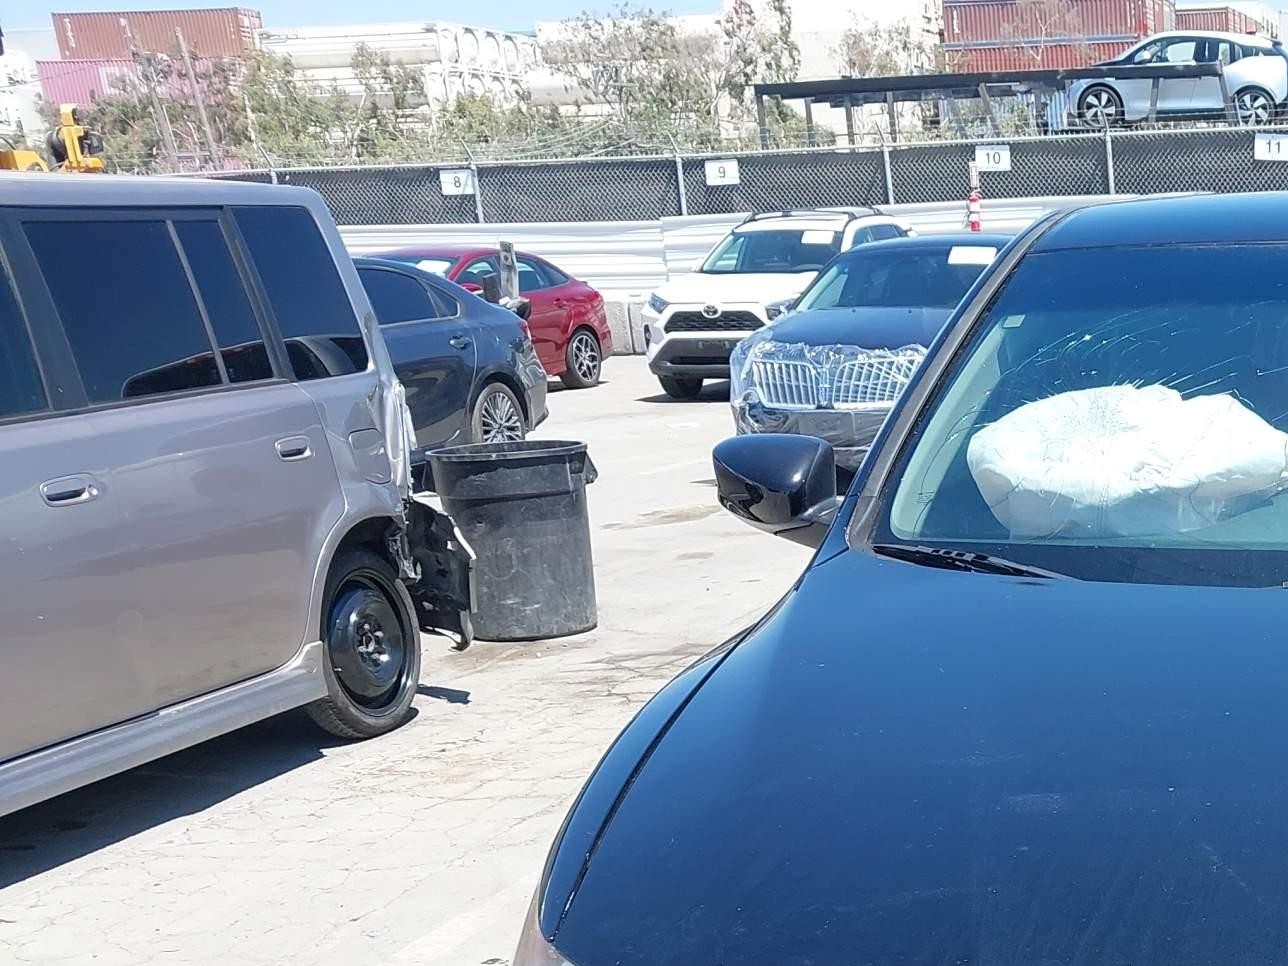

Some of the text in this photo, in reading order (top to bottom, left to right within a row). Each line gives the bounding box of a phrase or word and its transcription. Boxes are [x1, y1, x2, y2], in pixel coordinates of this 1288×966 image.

[1266, 140, 1280, 153] 11
[985, 152, 1001, 165] 10
[718, 166, 726, 178] 9
[453, 176, 462, 188] 8
